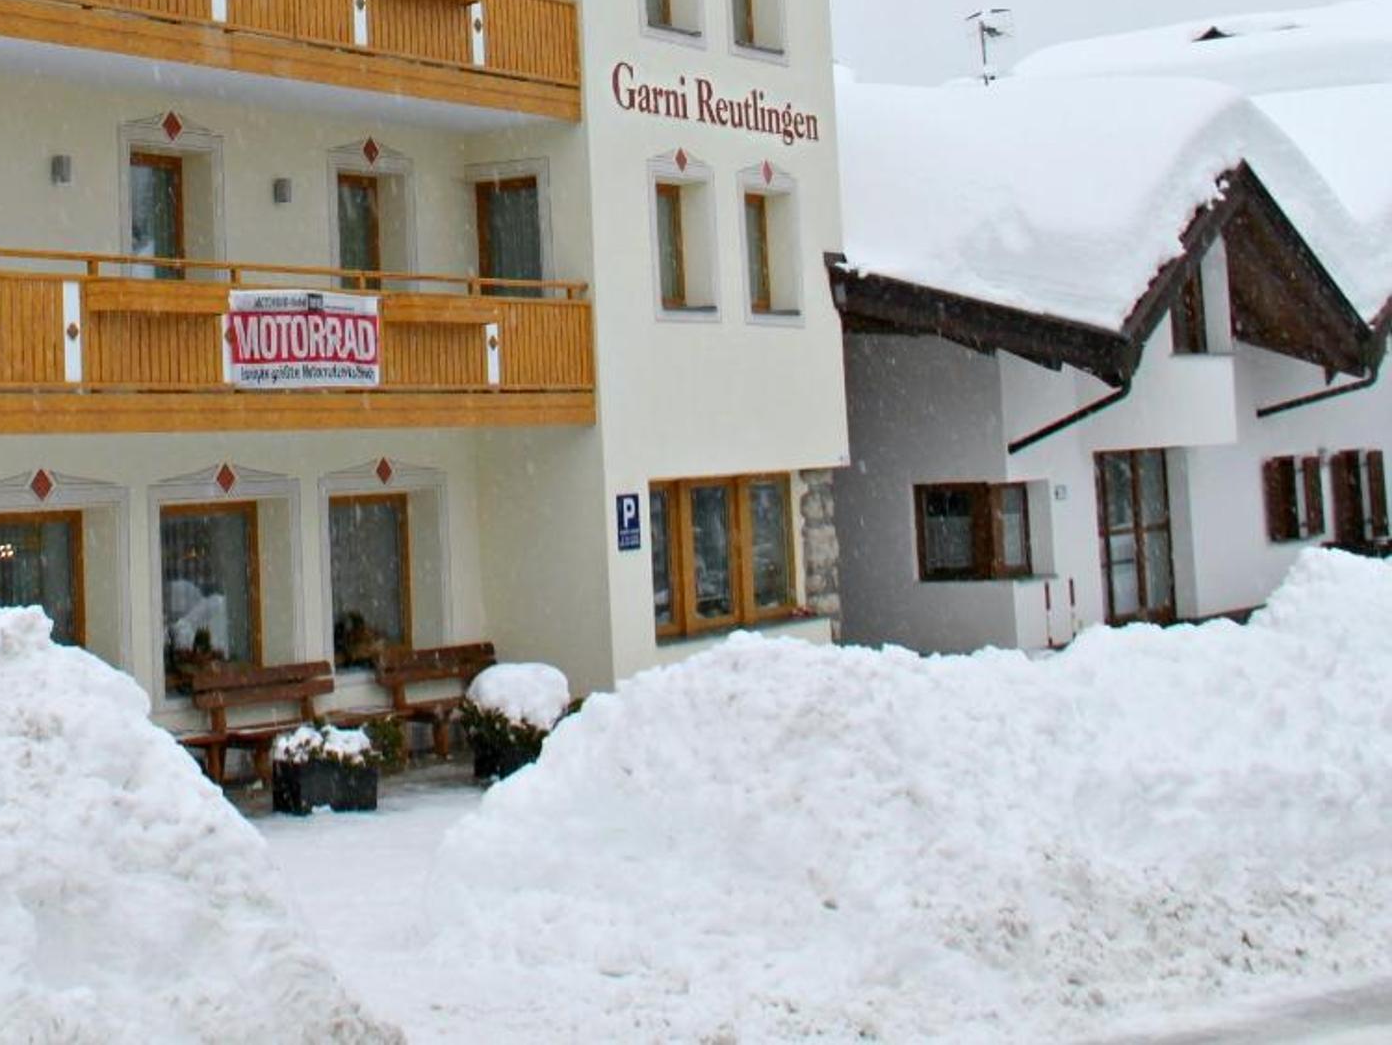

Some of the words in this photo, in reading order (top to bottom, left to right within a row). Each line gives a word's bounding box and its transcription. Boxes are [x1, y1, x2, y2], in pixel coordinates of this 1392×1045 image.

[612, 61, 688, 120] Garni
[695, 78, 819, 145] Reutlingen
[233, 314, 376, 361] MOTORRAD
[623, 498, 636, 528] P
